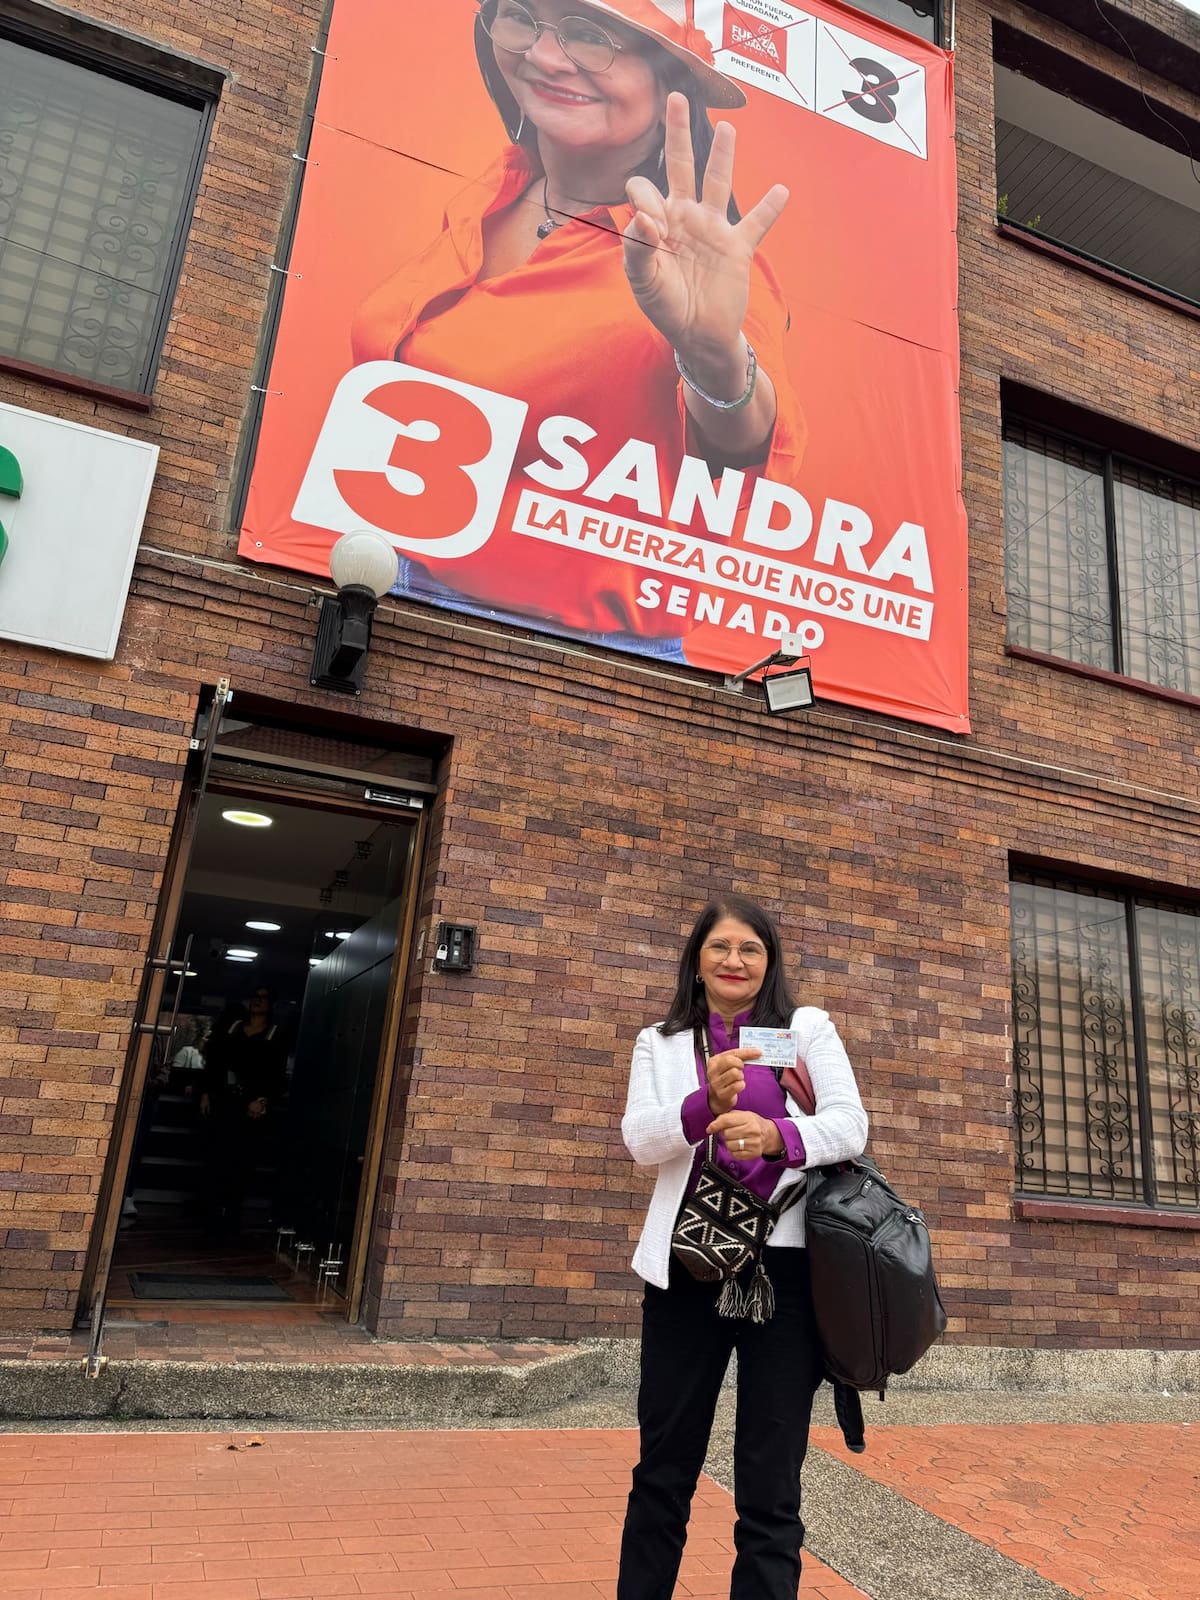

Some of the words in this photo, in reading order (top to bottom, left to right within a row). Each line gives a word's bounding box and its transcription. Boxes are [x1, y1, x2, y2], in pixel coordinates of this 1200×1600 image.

[736, 0, 780, 22] CIUDADANA
[764, 3, 794, 21] FUERZA
[731, 56, 781, 82] PREFERENTE
[842, 57, 900, 124] 3
[333, 380, 493, 540] 3
[523, 415, 935, 594] SANDRA
[526, 501, 568, 536] LA
[578, 516, 706, 573] FUERZA
[715, 555, 783, 592] QUE
[790, 574, 855, 611] NOS
[863, 593, 923, 630] UNE
[636, 578, 825, 649] SENADO
